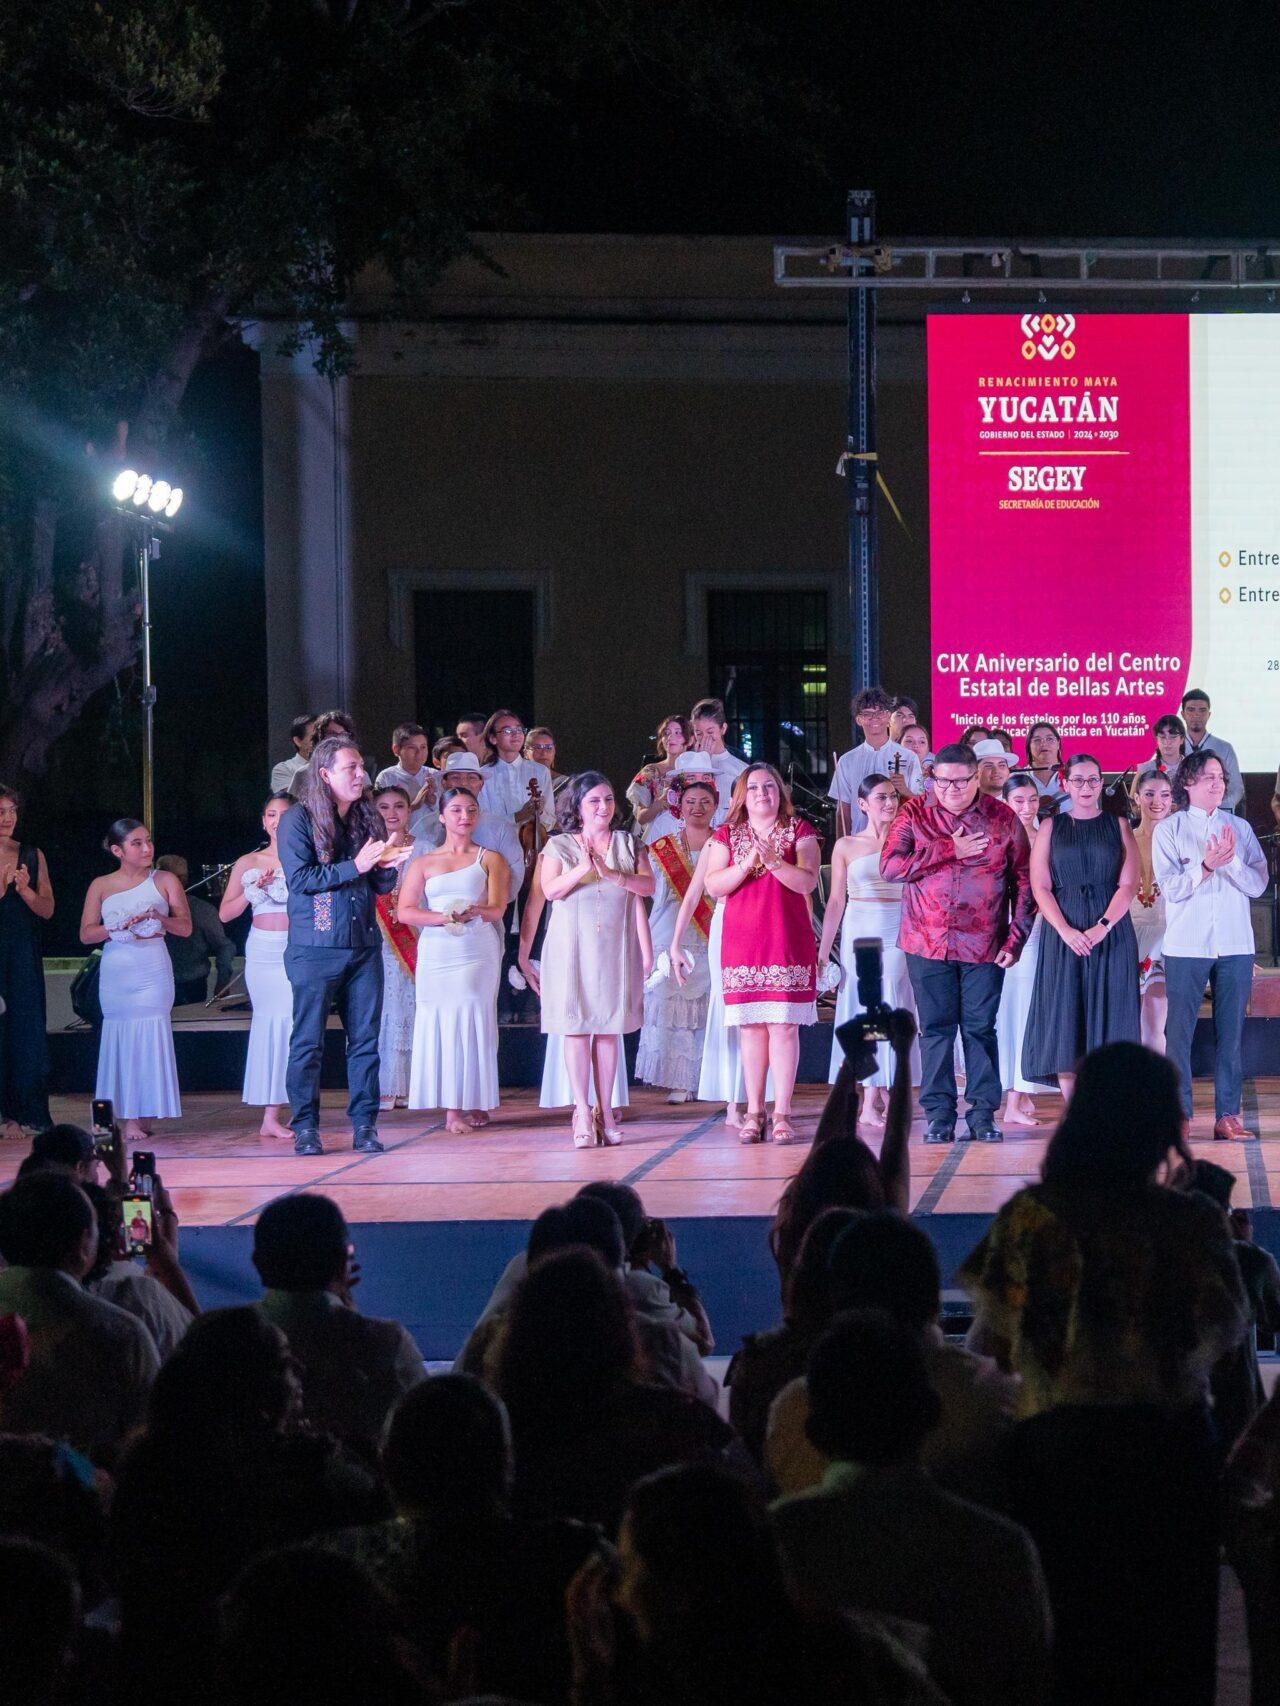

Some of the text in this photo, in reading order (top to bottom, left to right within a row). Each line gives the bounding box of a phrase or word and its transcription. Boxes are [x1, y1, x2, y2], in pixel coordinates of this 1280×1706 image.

[979, 377, 1118, 387] RENACIMIENTO MAYA
[978, 392, 1119, 423] YUCATÁN
[979, 430, 1018, 439] GOBIERNO
[1021, 430, 1034, 439] DEL
[1037, 430, 1065, 439] ESTADO
[1008, 466, 1086, 491] SEGEY
[999, 498, 1100, 510] SECRETARÍA DE EDUCACIÓN
[937, 652, 1181, 673] CIX Aniversario del Centro
[1267, 659, 1280, 671] 28
[960, 677, 1165, 697] Estatal de Bellas Artes
[987, 713, 999, 725] de
[1002, 713, 1017, 725] los
[1063, 715, 1080, 728] por
[1083, 712, 1097, 724] los
[1101, 712, 1119, 724] 110
[1122, 712, 1146, 724] años
[1057, 724, 1087, 736] tística
[1090, 728, 1102, 736] en
